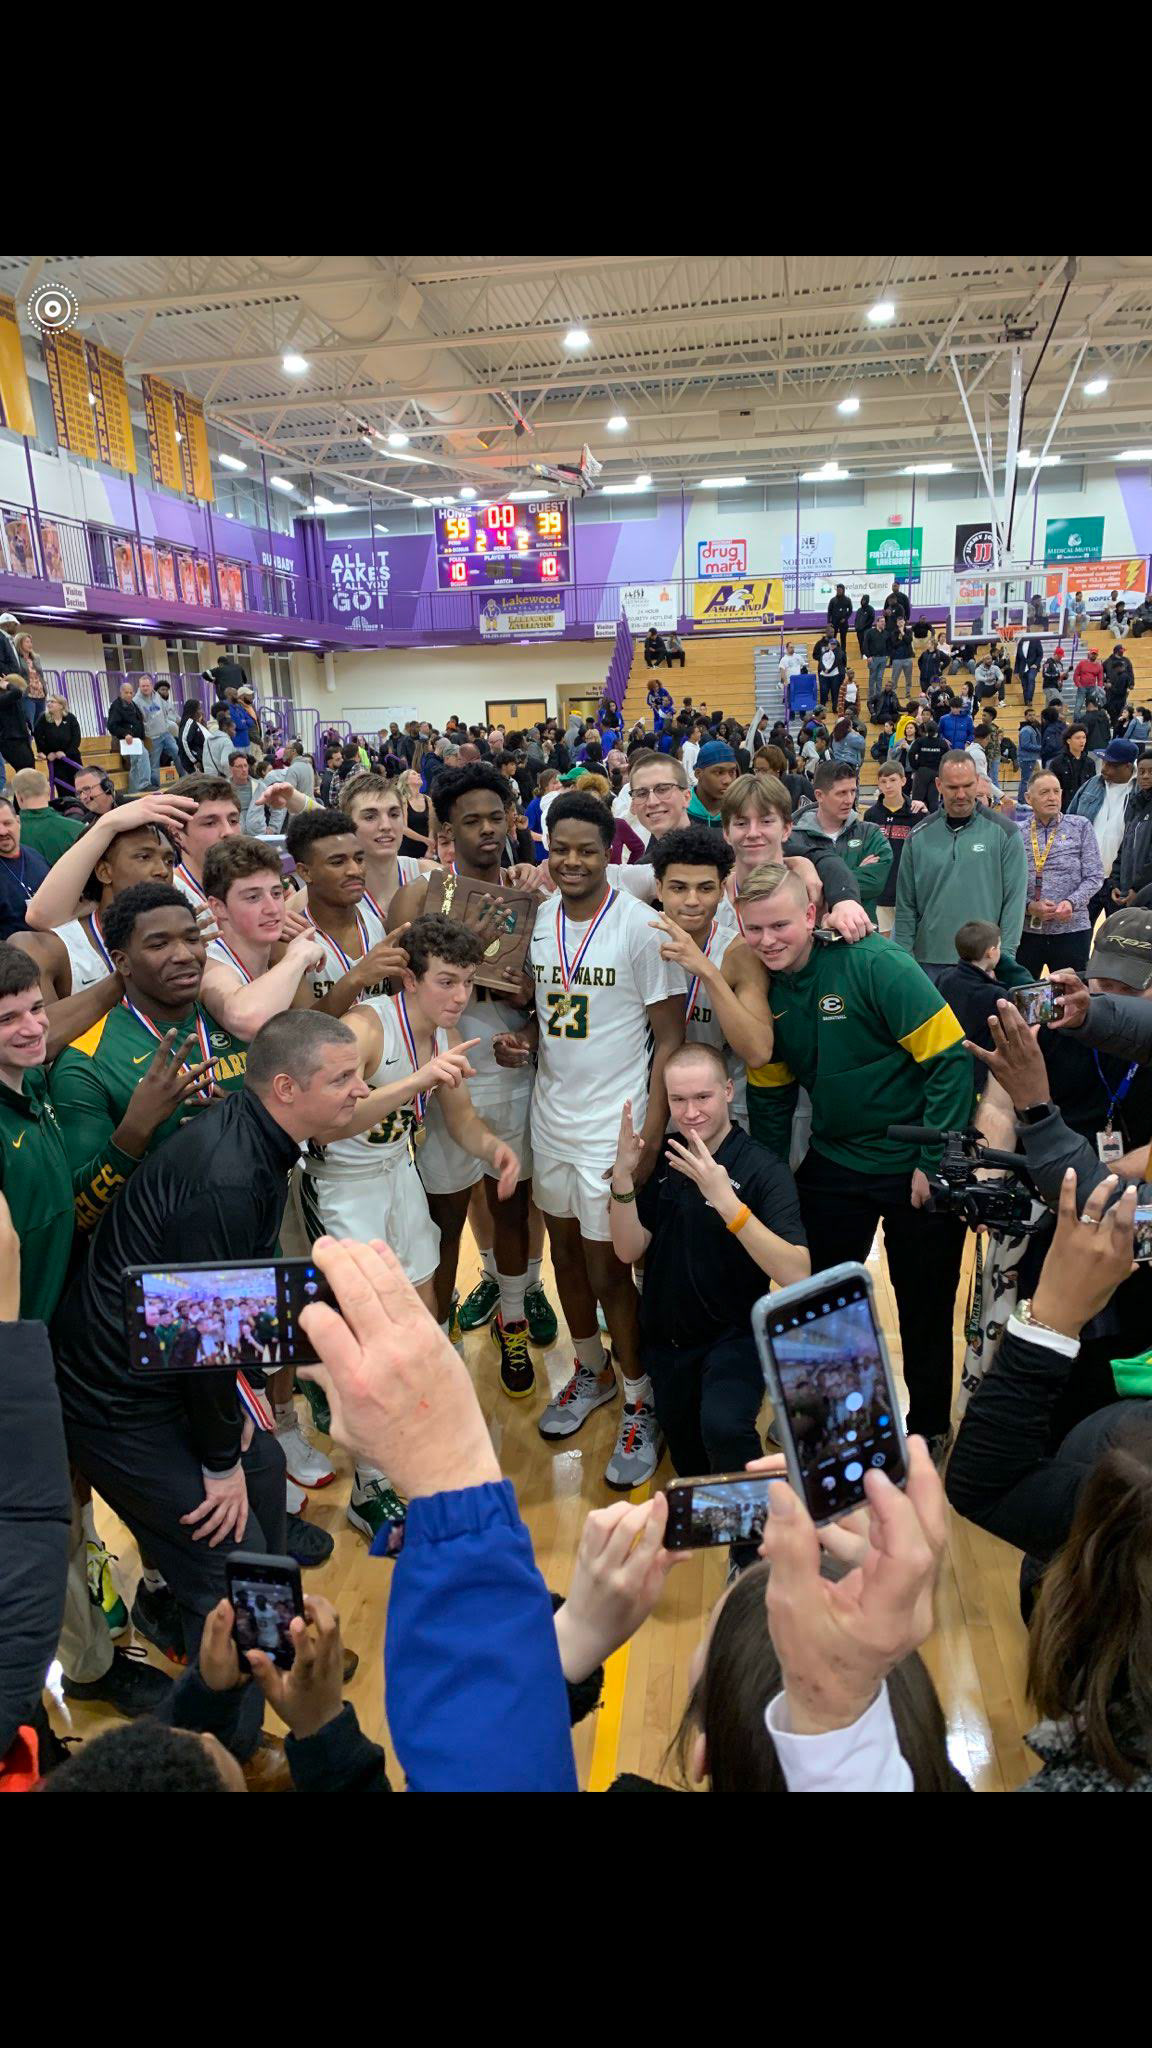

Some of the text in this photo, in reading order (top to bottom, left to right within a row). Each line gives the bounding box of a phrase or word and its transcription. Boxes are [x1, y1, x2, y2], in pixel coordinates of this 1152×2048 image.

[90, 370, 111, 463] TENNIS
[145, 397, 161, 483] TRACK
[439, 507, 472, 519] HOME
[528, 501, 565, 513] GUEST
[446, 517, 470, 538] 59
[538, 512, 561, 534] 39
[497, 530, 507, 546] 4
[966, 534, 983, 553] JIMMY
[331, 551, 389, 568] ALL IT
[702, 541, 738, 561] drug
[974, 543, 993, 562] JJ
[331, 566, 391, 583] TAKES
[452, 562, 466, 581] 10
[542, 558, 556, 575] 10
[706, 559, 746, 574] mart
[345, 582, 364, 590] ALL
[366, 580, 388, 589] YOU
[333, 589, 388, 612] GOT
[502, 594, 560, 607] Lakewood
[711, 604, 762, 612] ASHLAND
[552, 966, 616, 987] EWARD
[547, 992, 590, 1040] 23
